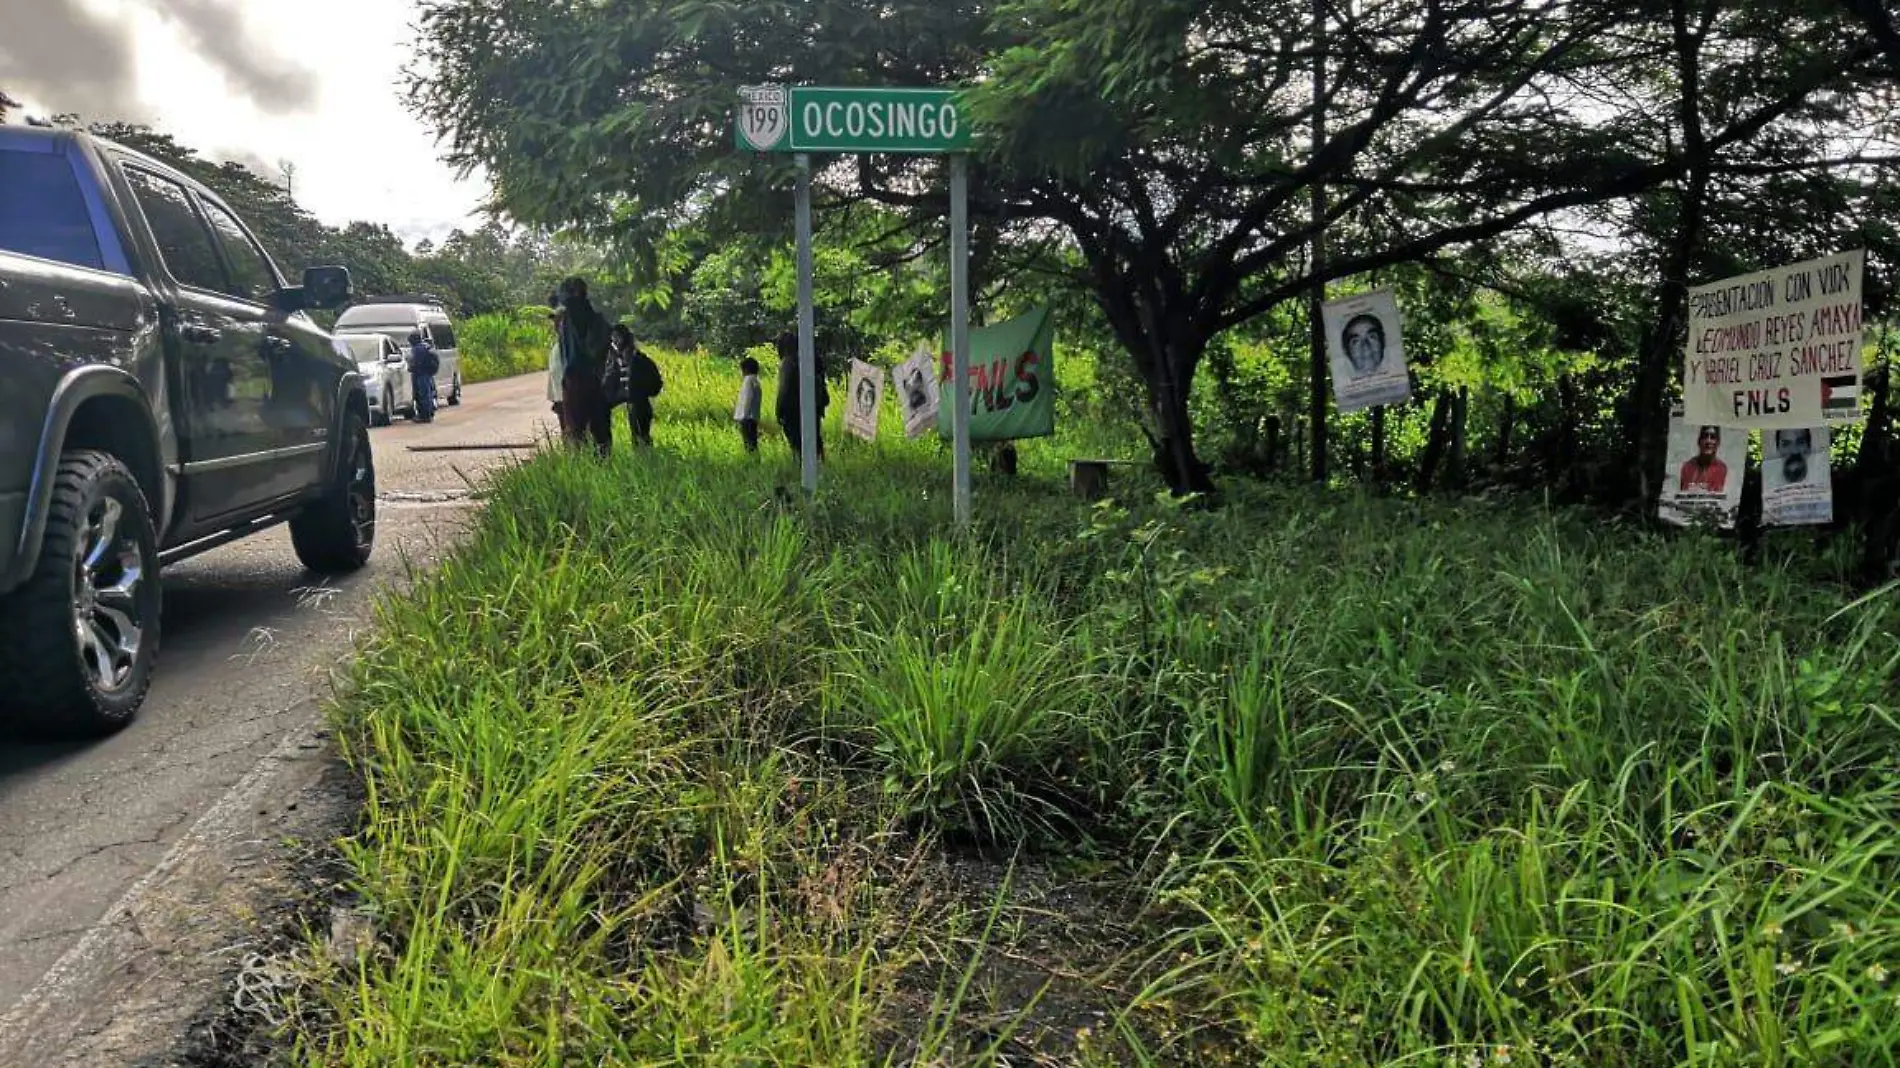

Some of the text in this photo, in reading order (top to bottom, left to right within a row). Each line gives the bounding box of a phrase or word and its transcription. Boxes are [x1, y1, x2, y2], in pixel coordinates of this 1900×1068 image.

[747, 107, 778, 133] 199
[803, 101, 958, 138] OCOSINGO
[1785, 271, 1811, 302] CON
[1765, 312, 1804, 347] REYES
[1809, 302, 1861, 338] AMAYA
[1689, 360, 1701, 384] Y
[1749, 352, 1782, 383] CRUZ
[1733, 387, 1791, 418] FNLS
